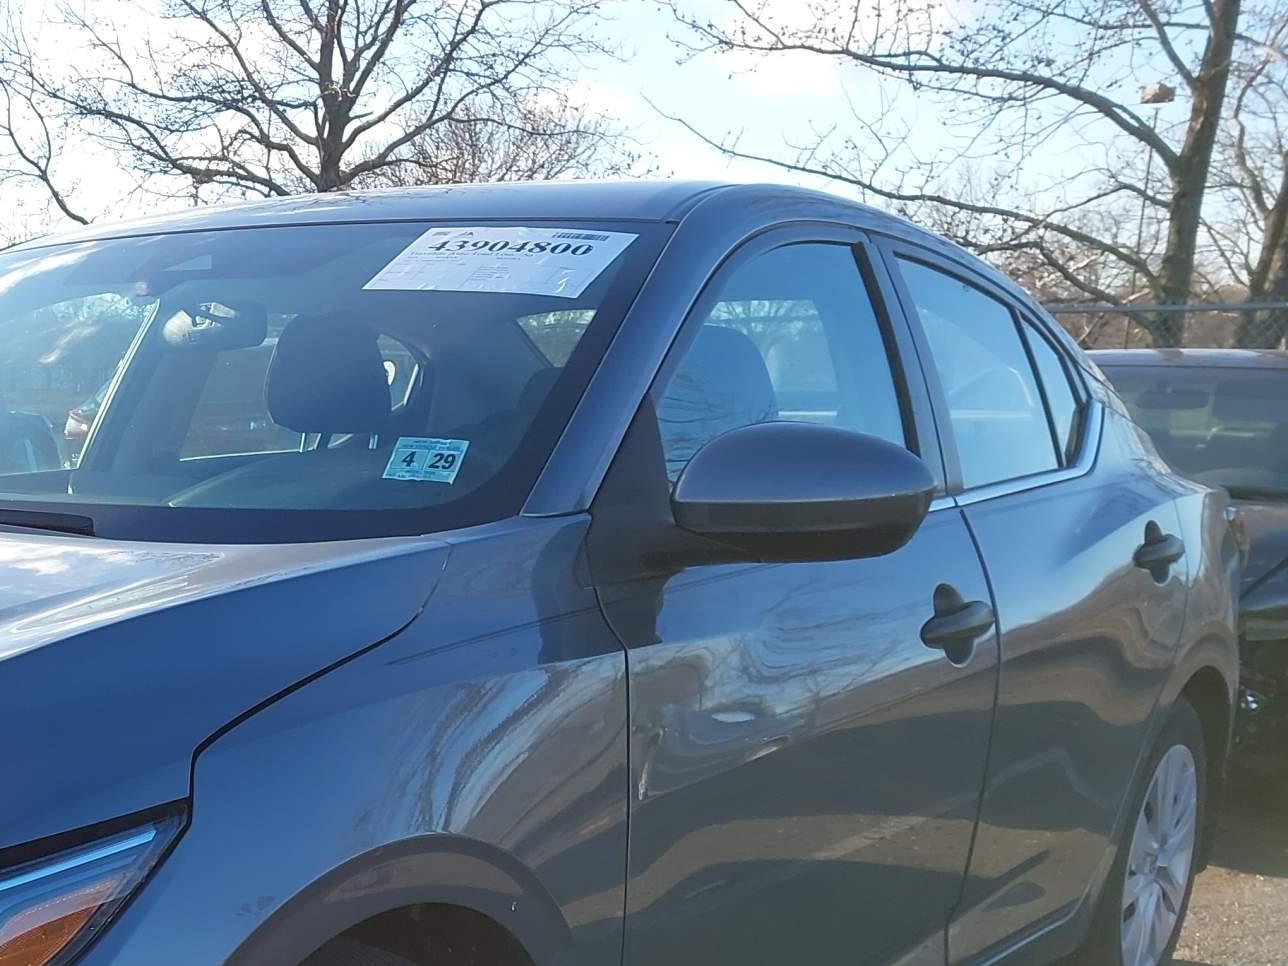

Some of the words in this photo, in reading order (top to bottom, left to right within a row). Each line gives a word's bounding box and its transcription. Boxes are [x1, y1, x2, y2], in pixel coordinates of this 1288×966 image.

[428, 239, 594, 256] 43904800
[401, 451, 416, 467] 4
[428, 453, 456, 470] 29
